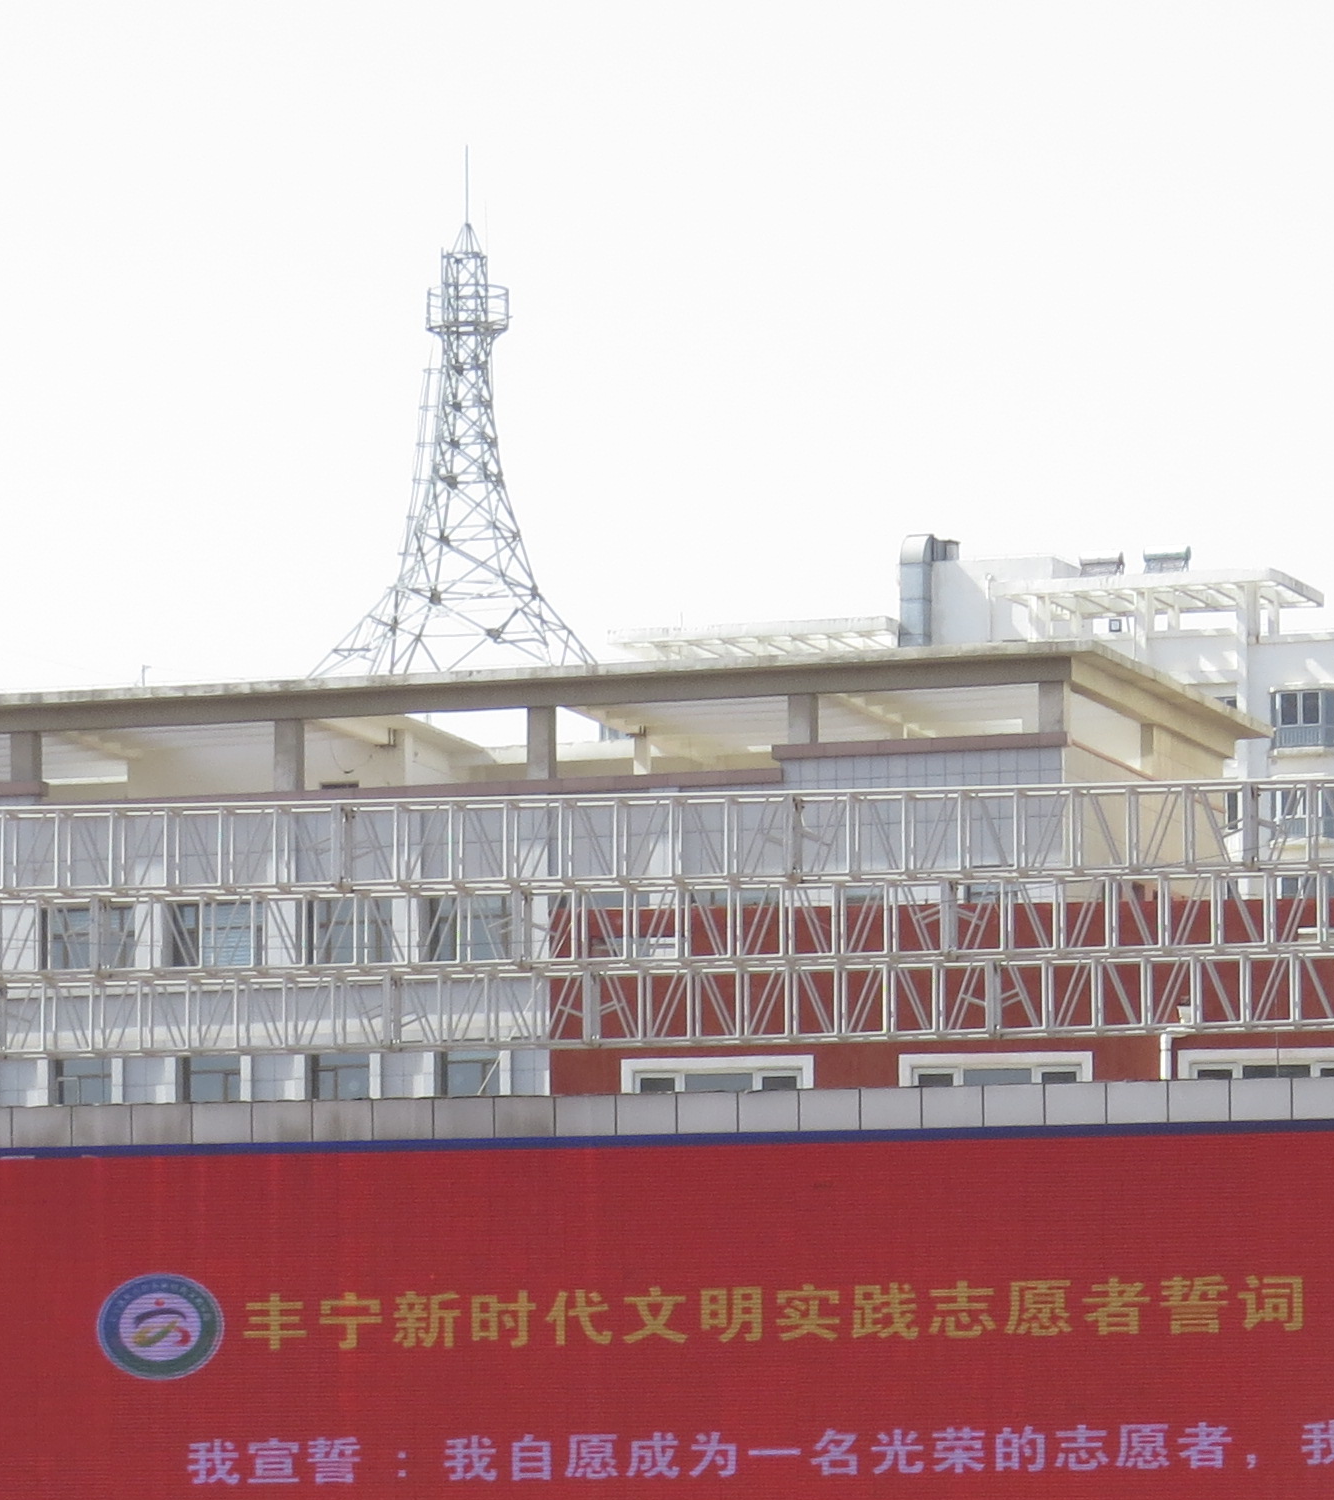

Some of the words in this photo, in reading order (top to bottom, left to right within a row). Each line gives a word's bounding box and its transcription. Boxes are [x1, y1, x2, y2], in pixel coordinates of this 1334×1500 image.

[242, 1275, 1305, 1352] 丰宁新时代文明实践志愿者誓词
